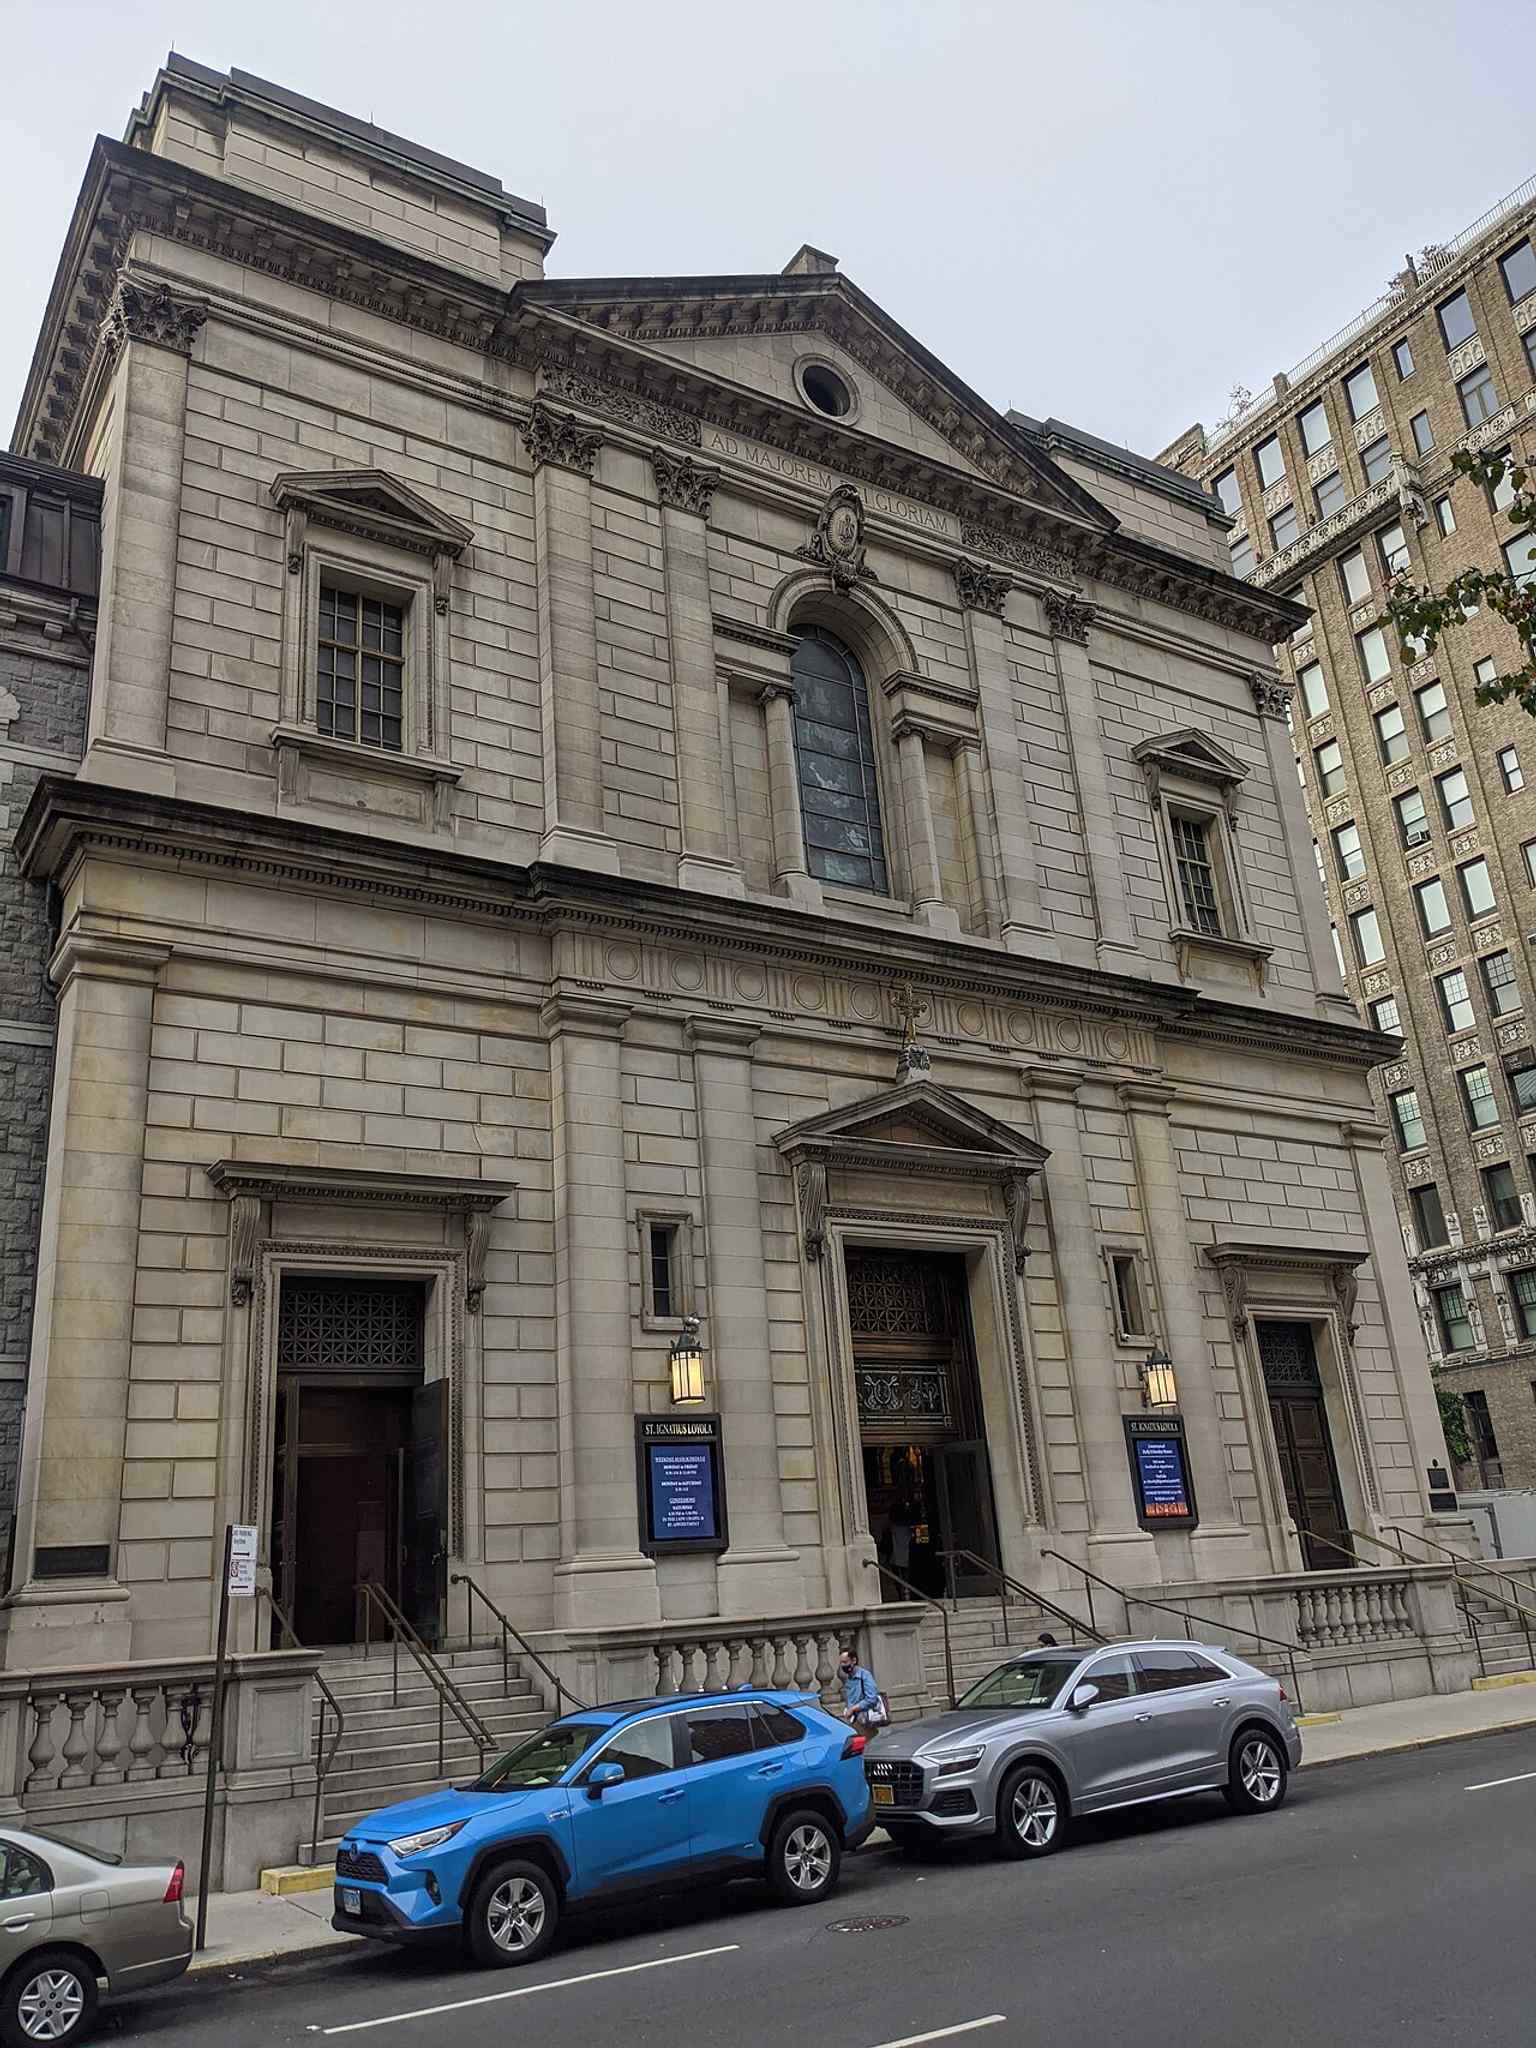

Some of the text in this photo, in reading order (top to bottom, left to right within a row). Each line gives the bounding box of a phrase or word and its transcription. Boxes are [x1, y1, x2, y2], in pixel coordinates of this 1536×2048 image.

[711, 433, 738, 455] AD
[745, 445, 832, 490] MAJOREM
[875, 493, 949, 533] GLORIAM
[645, 1423, 713, 1435] ST. IGNATIUS LOYOLA
